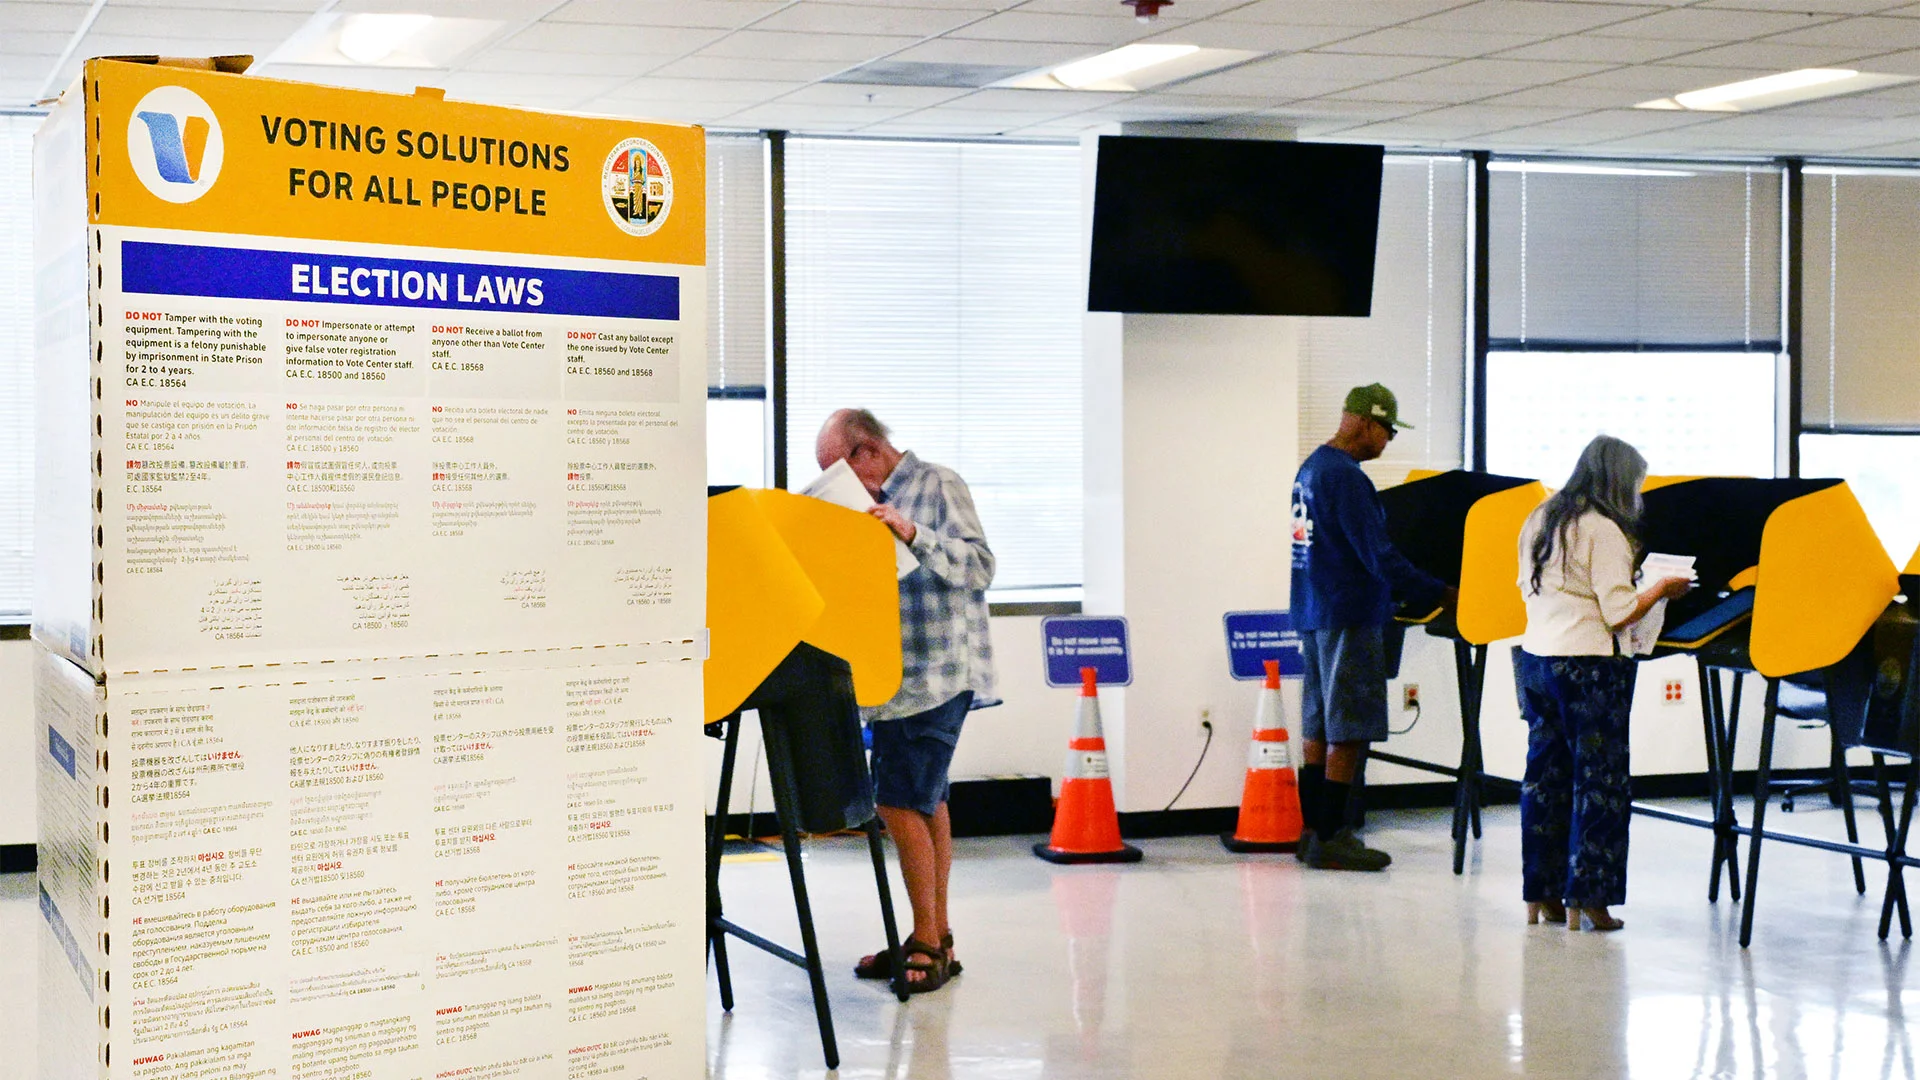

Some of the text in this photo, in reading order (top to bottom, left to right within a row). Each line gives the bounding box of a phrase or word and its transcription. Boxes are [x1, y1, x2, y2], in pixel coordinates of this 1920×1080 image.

[261, 115, 386, 154] VOTING
[397, 130, 570, 172] SOLUTIONS
[290, 168, 546, 216] FOR ALL PEOPLE
[292, 264, 543, 306] ELECTION LAWS
[125, 311, 262, 328] DO NOT Tamper with the voting
[285, 318, 299, 327] DO
[301, 319, 319, 327] NOT
[322, 321, 372, 330] Impersonate
[384, 324, 415, 333] attempt
[125, 325, 257, 339] equipment. Tampering with the
[432, 325, 444, 333] DO
[446, 326, 463, 334] NOT
[465, 327, 494, 335] Receive
[502, 328, 523, 337] ballot
[525, 329, 542, 337] from
[296, 332, 347, 342] impersonate
[349, 336, 378, 344] anyone
[567, 331, 673, 344] DO NOT Cast any ballot except
[125, 338, 172, 348] equipment
[174, 340, 181, 348] is
[191, 340, 218, 351] felony
[220, 342, 266, 351] punishable
[431, 339, 459, 347] anyone
[461, 339, 481, 347] other
[502, 340, 518, 348] Vote
[520, 341, 545, 349] Center
[567, 343, 579, 352] the
[595, 344, 617, 352] issued
[619, 345, 627, 355] by
[645, 346, 669, 354] Center
[285, 344, 396, 357] give false voter registration
[432, 350, 451, 358] staff.
[125, 351, 262, 364] by imprisonment in State Prison
[286, 357, 333, 366] information
[346, 359, 364, 367] Vote
[365, 359, 392, 368] Center
[125, 364, 138, 373] for
[141, 364, 146, 373] 2
[168, 367, 194, 376] years.
[431, 361, 442, 370] CA
[461, 363, 484, 371] 18568
[567, 366, 577, 374] CA
[594, 367, 615, 375] 18560
[617, 368, 630, 376] and
[631, 368, 652, 376] 18568
[286, 369, 298, 378] CA
[317, 370, 342, 379] 18500
[361, 372, 385, 380] 18560
[125, 377, 138, 386] CA
[160, 378, 186, 387] 18564
[365, 773, 384, 781] 18560
[132, 897, 142, 905] CA
[166, 891, 185, 901] 18564
[132, 981, 142, 989] CA
[158, 976, 178, 985] 18564
[568, 985, 593, 994] HUWAG
[436, 1006, 462, 1015] HUWAG
[292, 1029, 320, 1039] HUWAG
[133, 1054, 164, 1065] HUWAG
